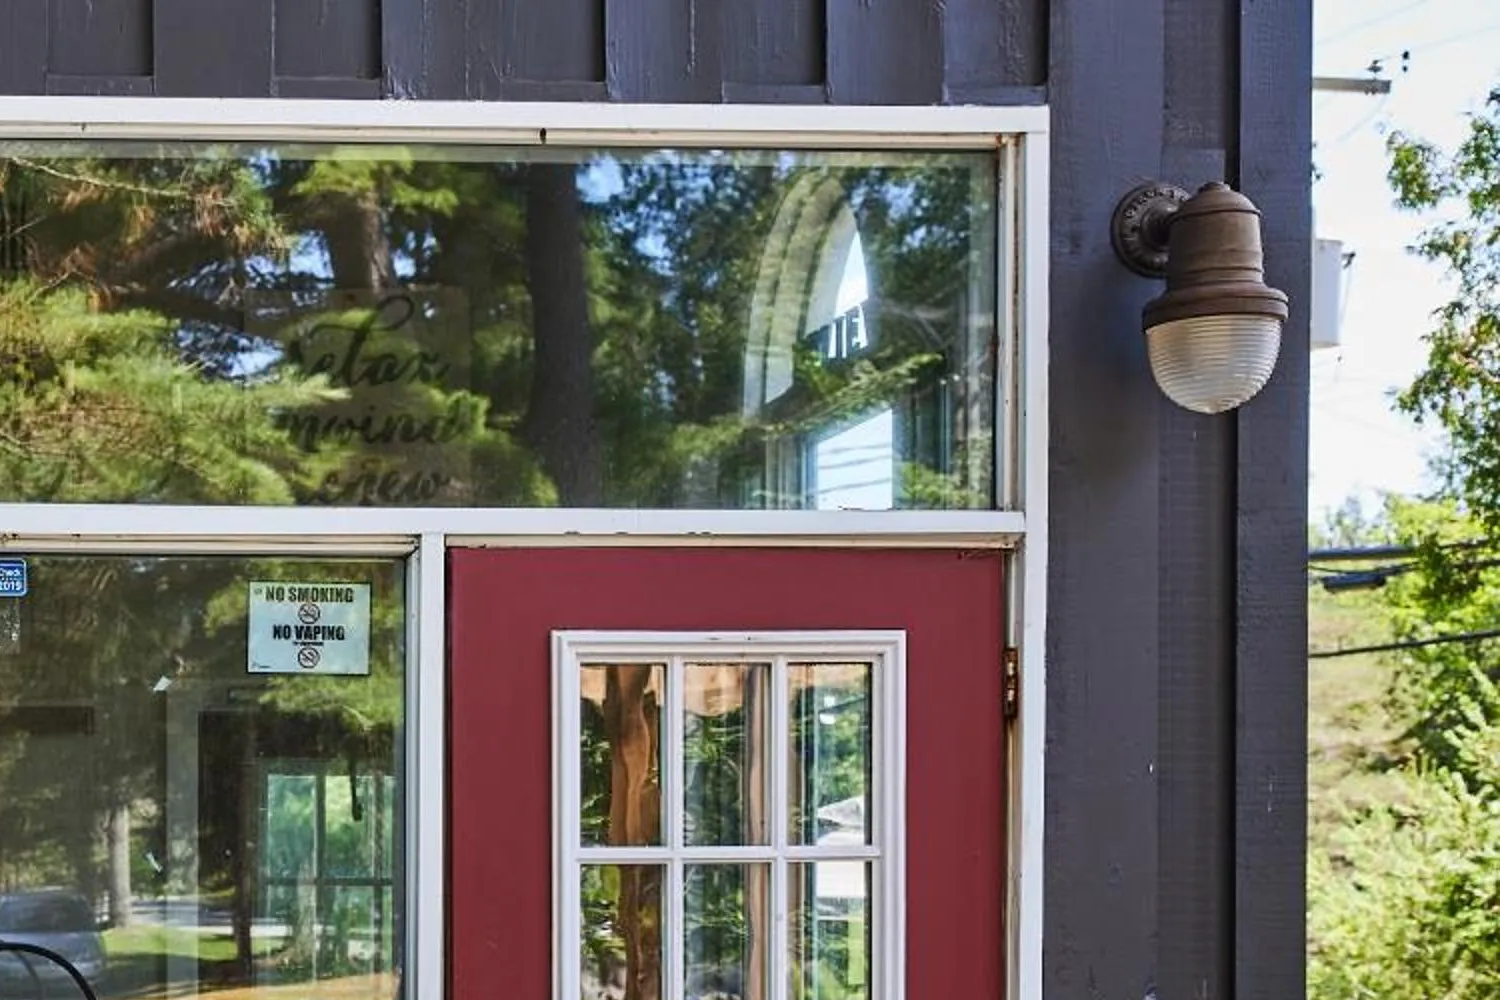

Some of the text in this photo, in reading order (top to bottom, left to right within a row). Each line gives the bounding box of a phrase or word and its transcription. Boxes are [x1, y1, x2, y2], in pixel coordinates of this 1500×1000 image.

[265, 586, 355, 604] NO SMOKING
[272, 624, 346, 641] NO VAPING
